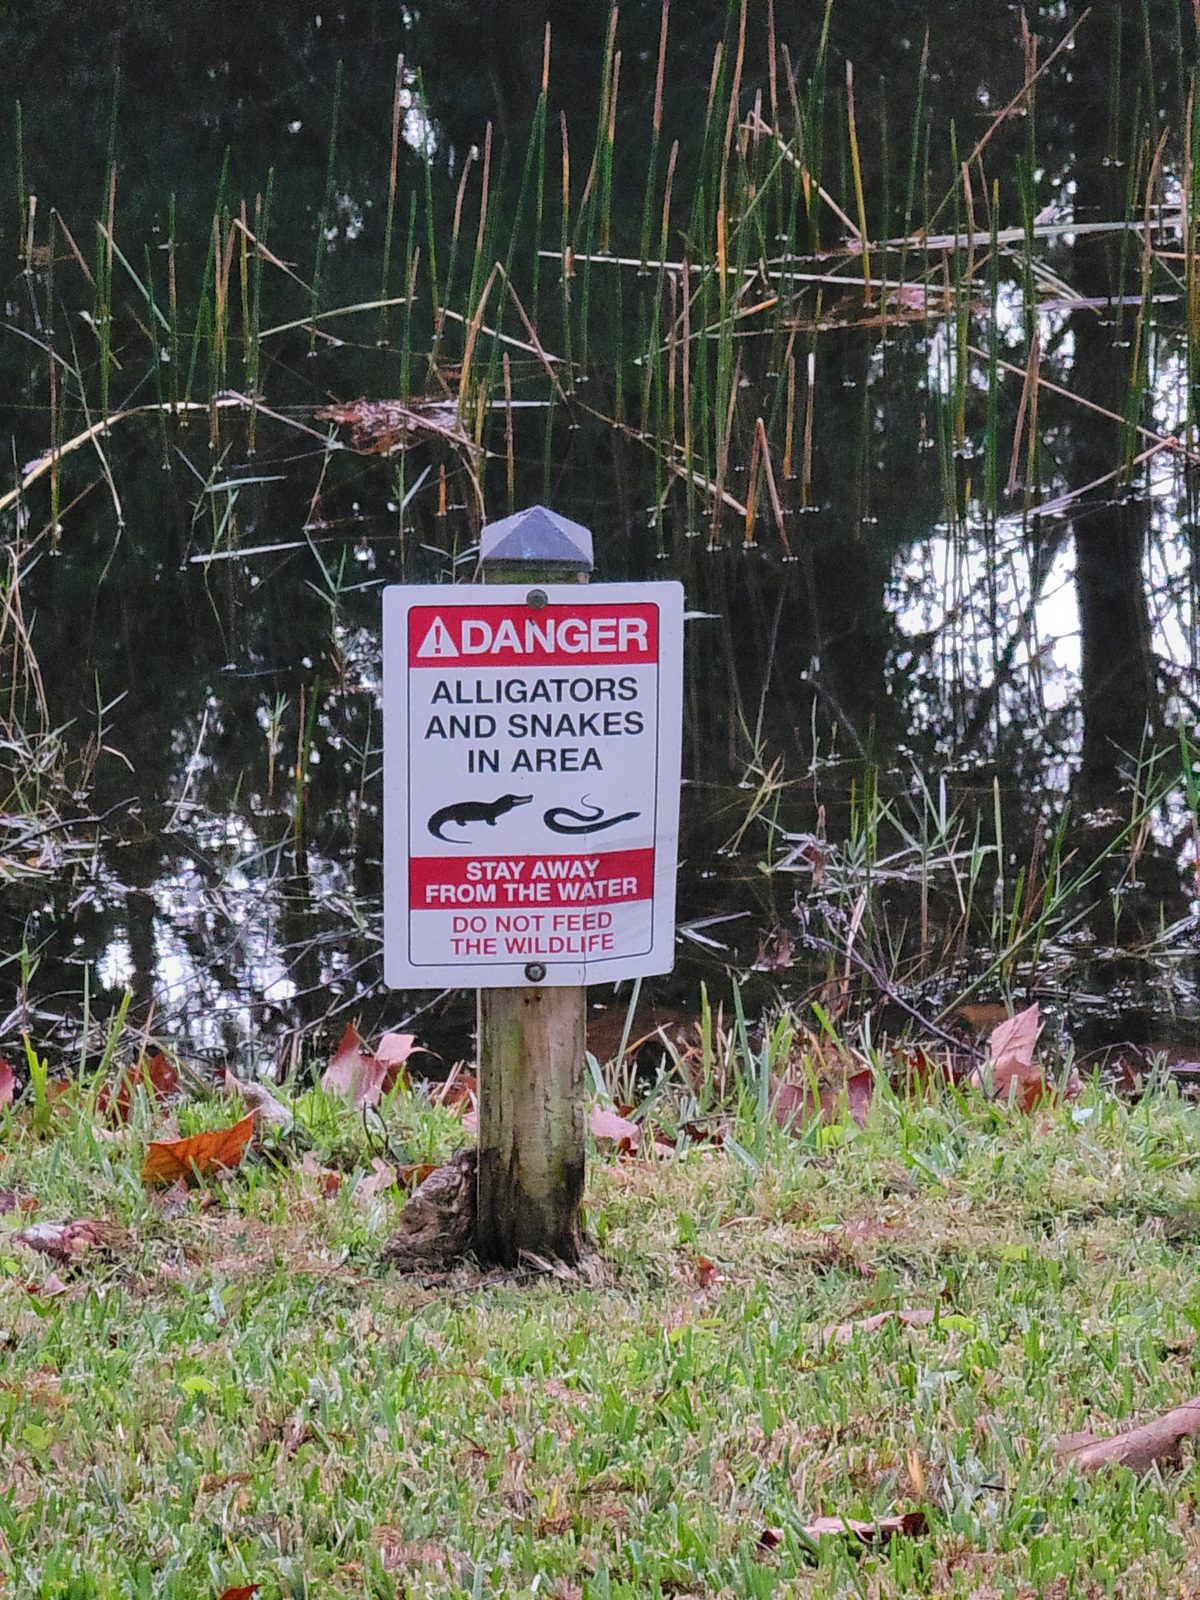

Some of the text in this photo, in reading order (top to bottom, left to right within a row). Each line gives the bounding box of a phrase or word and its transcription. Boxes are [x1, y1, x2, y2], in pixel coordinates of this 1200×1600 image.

[462, 618, 648, 655] DANGER
[432, 677, 638, 705] ALLIGATORS
[425, 711, 644, 739] AND SNAKES
[469, 748, 603, 773] IN AREA
[466, 860, 600, 881] STAY AWAY
[425, 877, 637, 903] FROM THE WATER
[452, 912, 613, 934] DO NOT FEED
[451, 934, 614, 956] THE WILDLIFE
